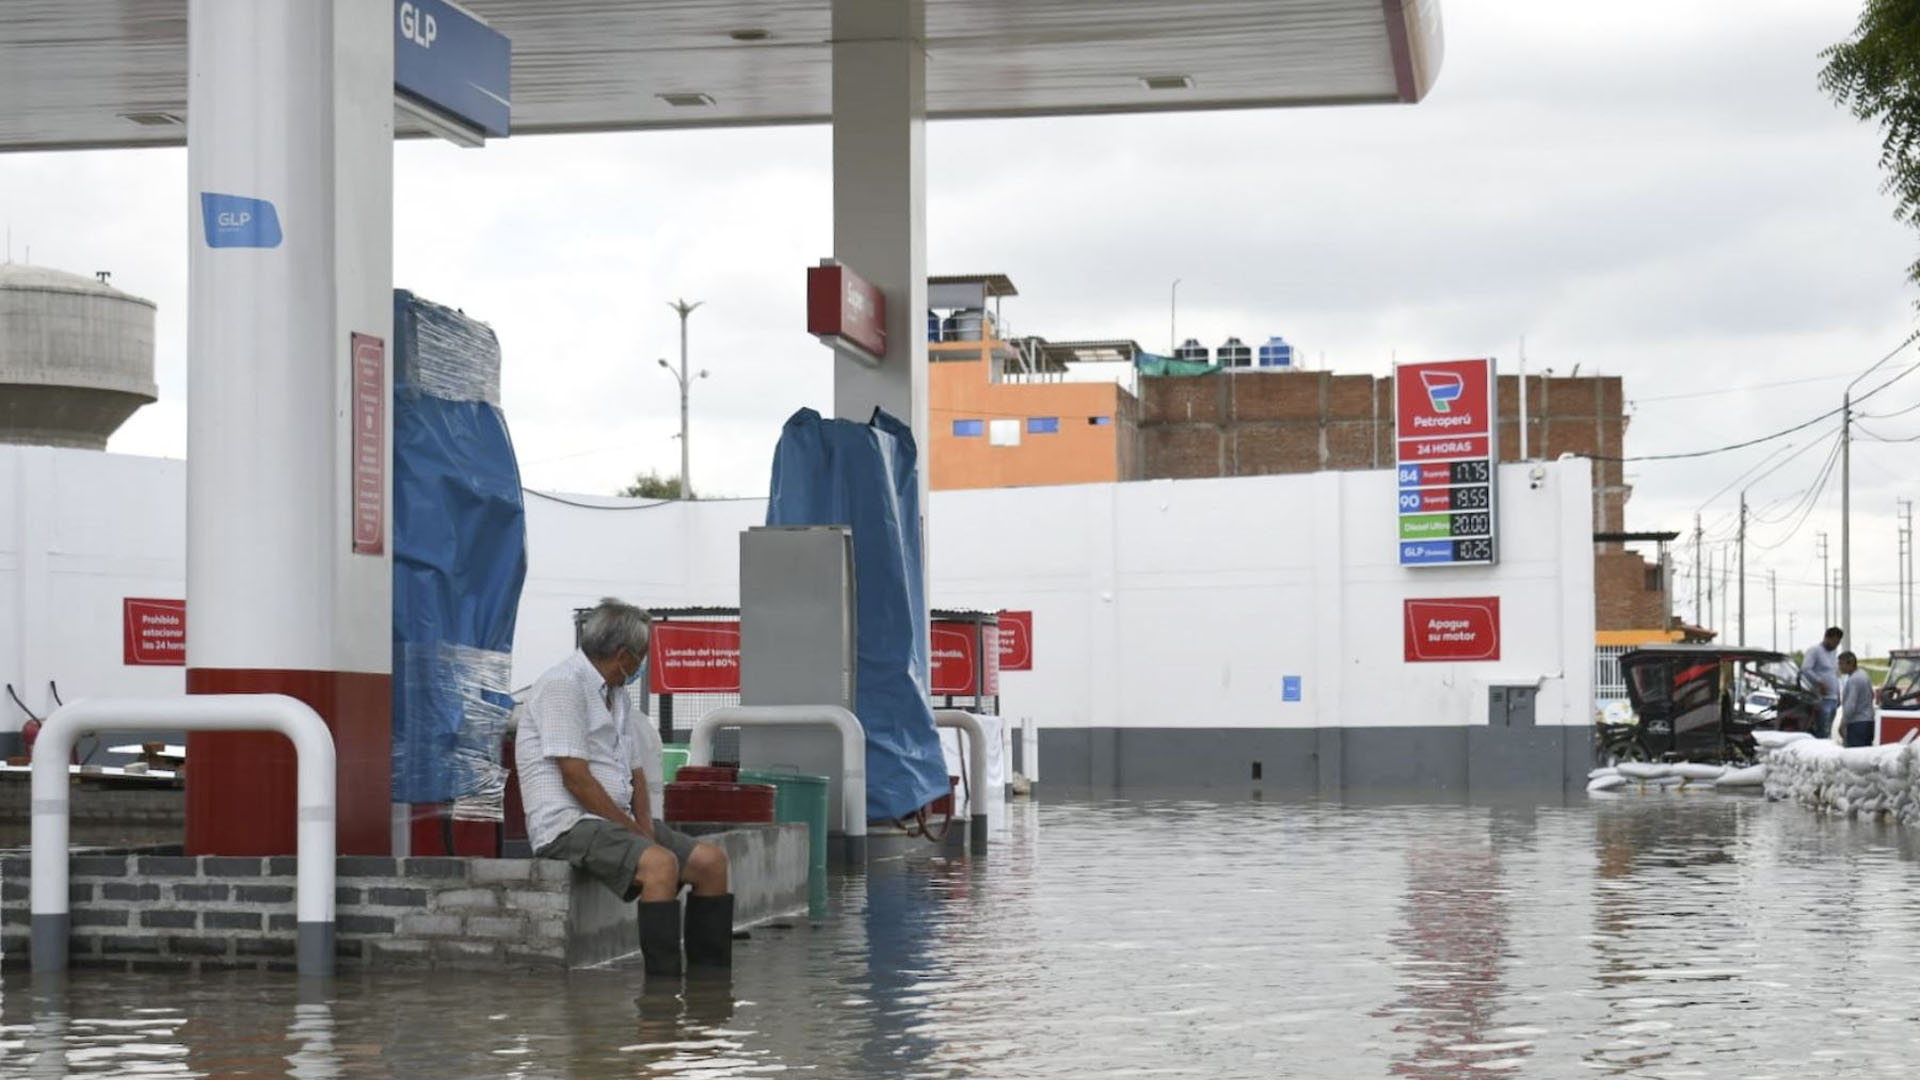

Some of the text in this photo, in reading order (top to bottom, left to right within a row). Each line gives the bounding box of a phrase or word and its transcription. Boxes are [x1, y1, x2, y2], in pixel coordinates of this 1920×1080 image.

[400, 1, 437, 49] GLP
[218, 212, 251, 226] GLP
[1414, 413, 1472, 428] Petroperú
[1417, 441, 1472, 455] 24 HORAS
[1400, 470, 1418, 482] 84
[1400, 494, 1419, 508] 90
[1457, 488, 1487, 507] 19.55
[1453, 515, 1487, 534] 20.00
[1404, 546, 1425, 557] GLP
[1460, 540, 1490, 558] 10.25
[1428, 619, 1469, 631] Apague
[1428, 631, 1476, 642] su motor
[154, 640, 166, 650] 24
[697, 648, 710, 657] del
[715, 658, 738, 668] 80%
